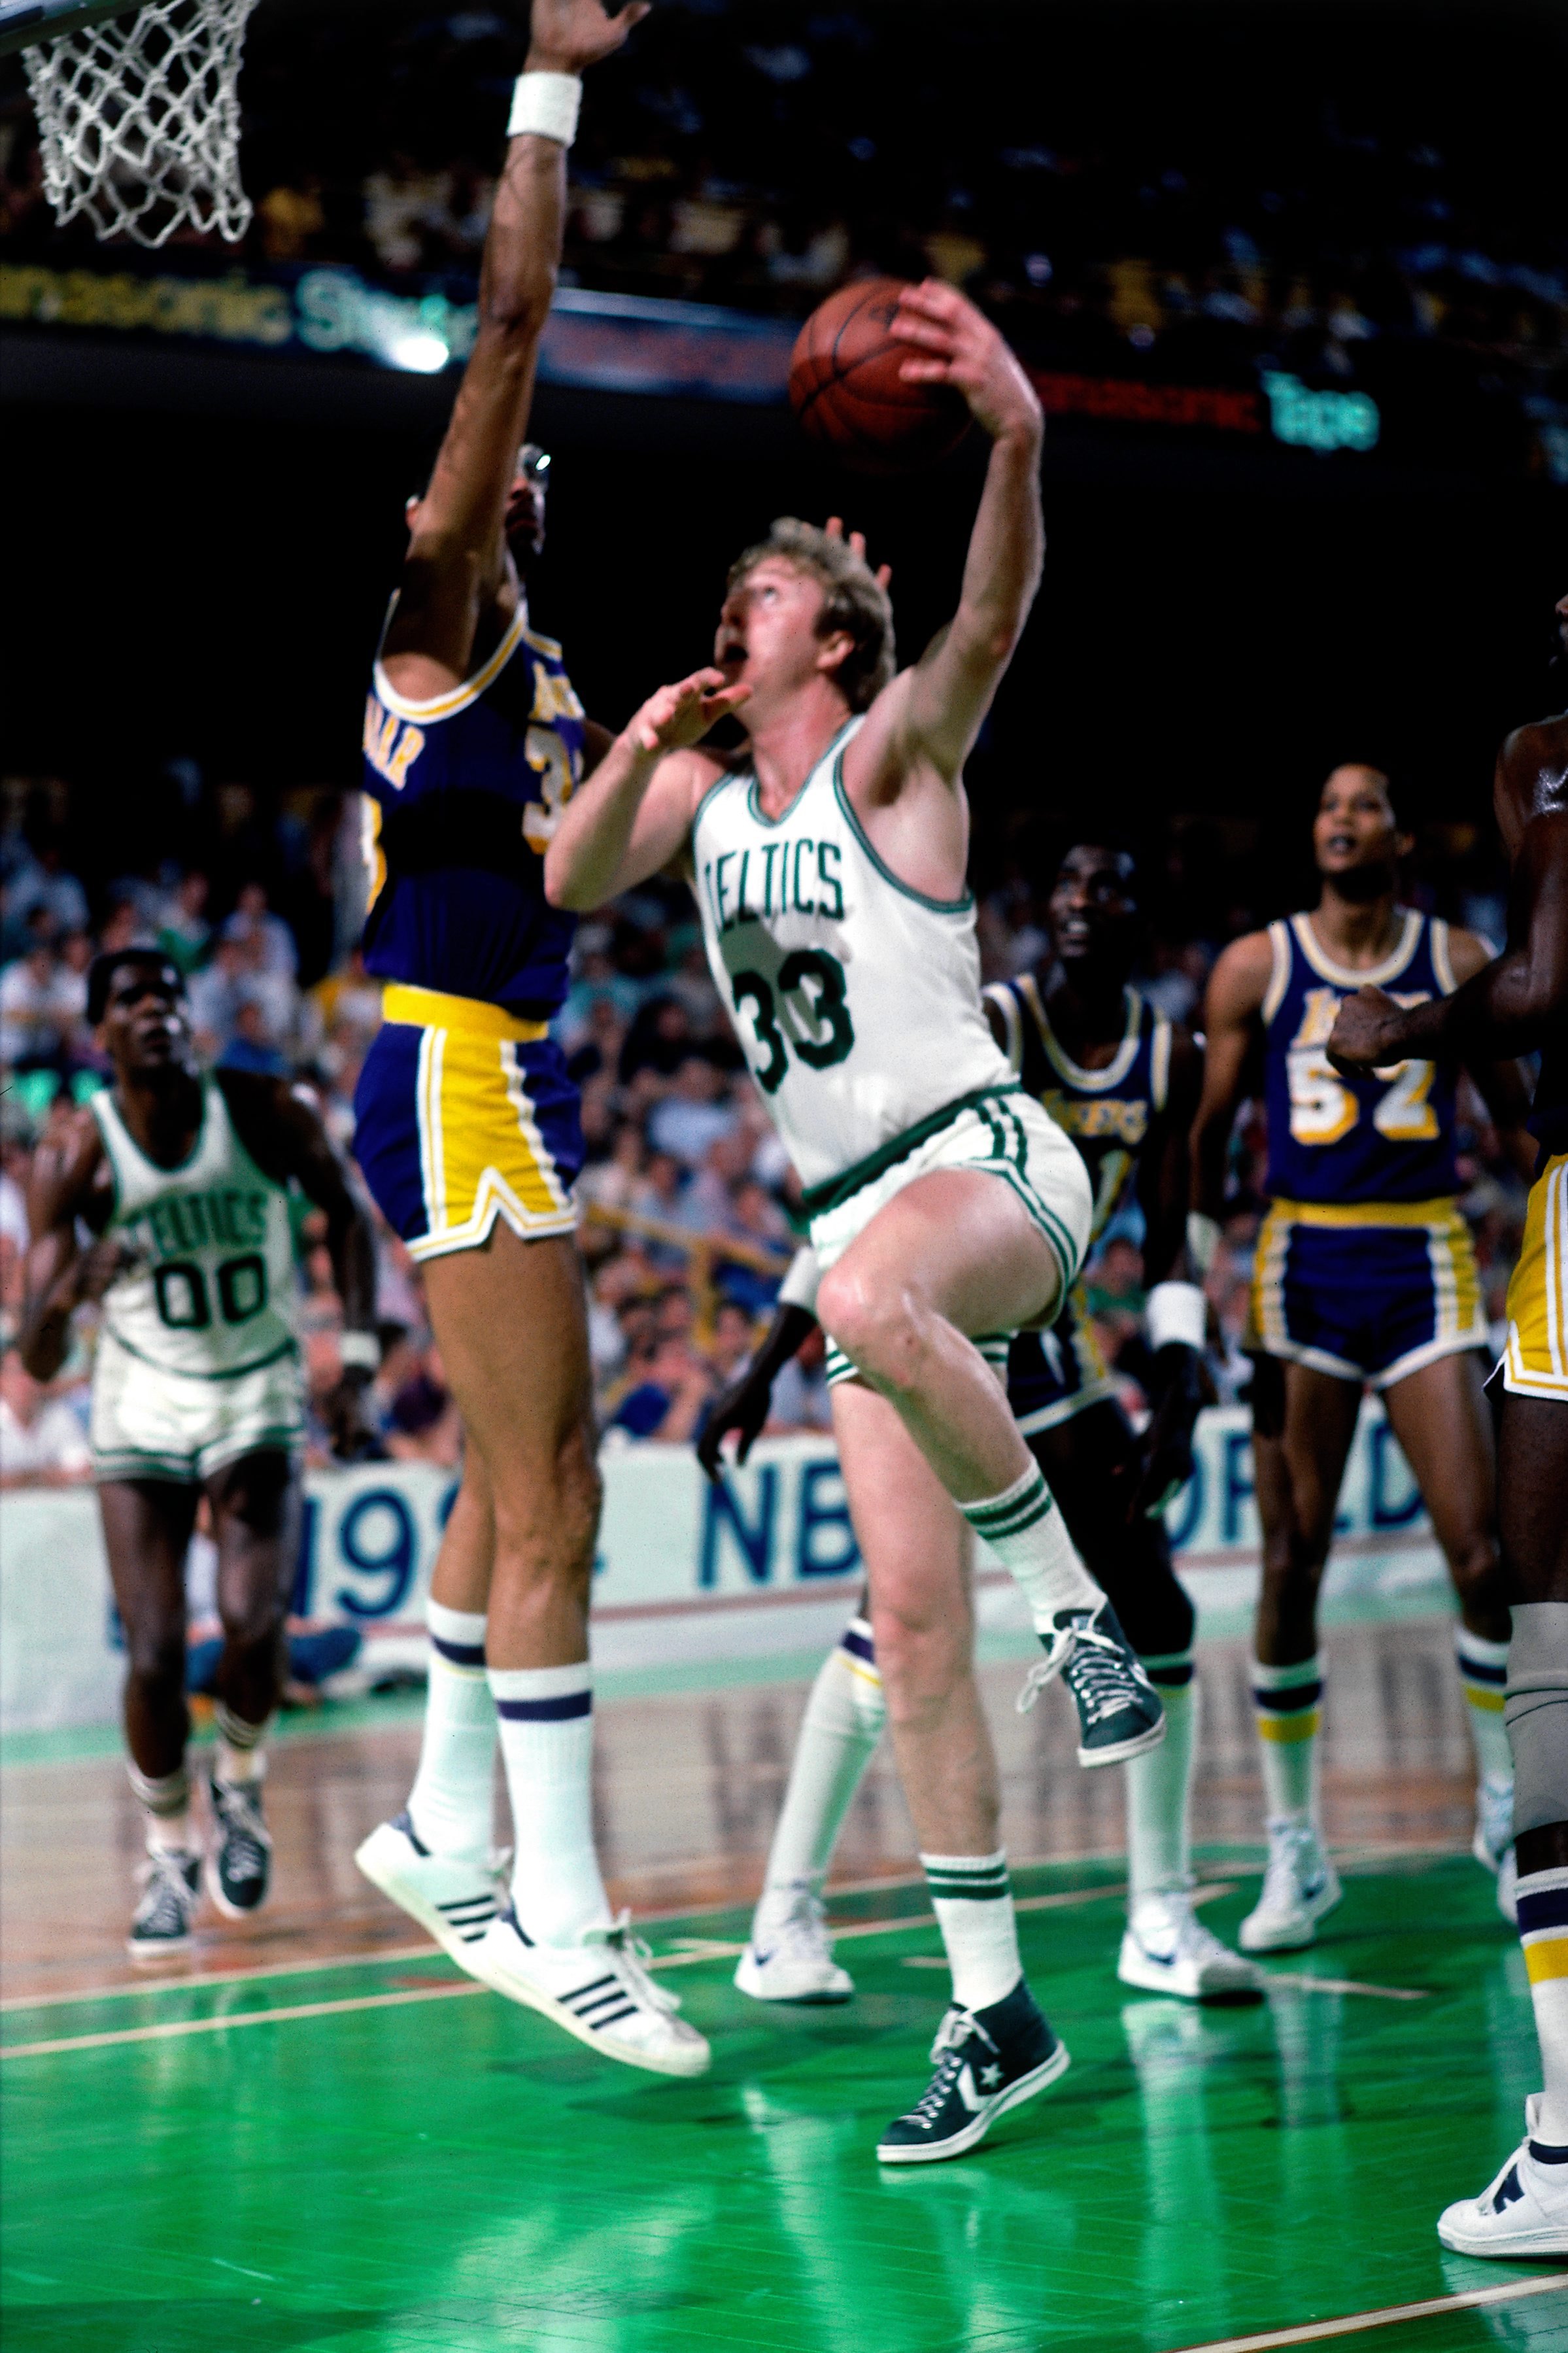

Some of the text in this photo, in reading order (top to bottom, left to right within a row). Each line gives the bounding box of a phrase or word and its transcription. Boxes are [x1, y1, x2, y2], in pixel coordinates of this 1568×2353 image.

[732, 948, 855, 1094] 33
[1286, 1050, 1440, 1146] 52
[155, 1254, 267, 1330] 00
[697, 1457, 862, 1590] NB
